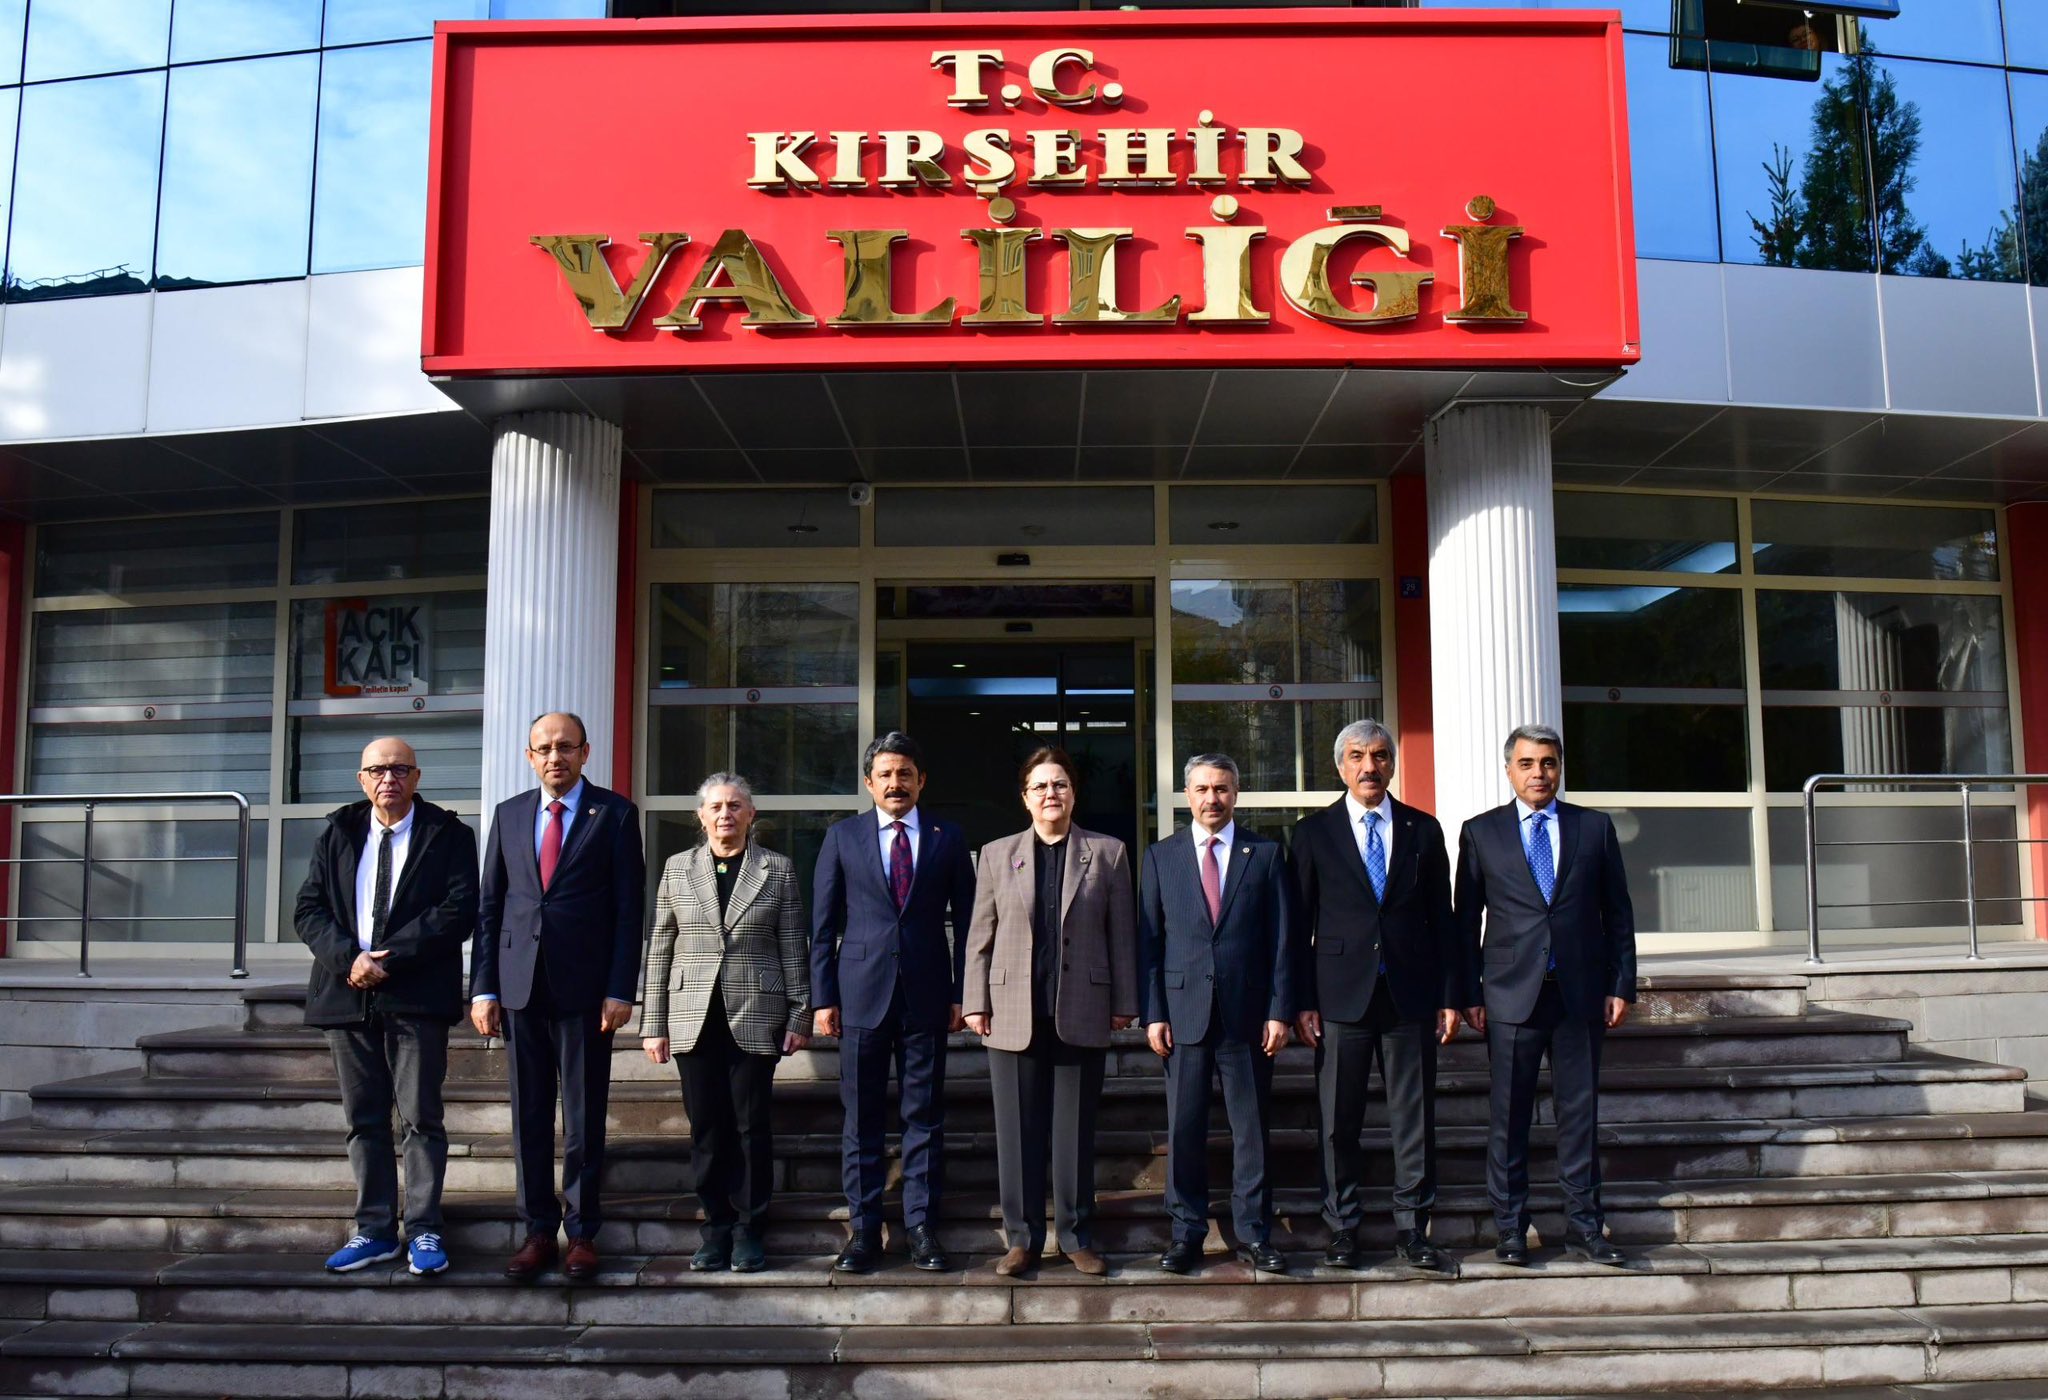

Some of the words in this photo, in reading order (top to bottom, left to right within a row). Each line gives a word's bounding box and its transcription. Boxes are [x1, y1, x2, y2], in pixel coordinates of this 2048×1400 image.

[930, 48, 1124, 108] T.C.
[746, 109, 1312, 199] KIRŞEHİR
[529, 195, 1530, 333] VALİLİĞİ
[338, 606, 423, 645] AÇIK
[337, 642, 420, 682] KAPI
